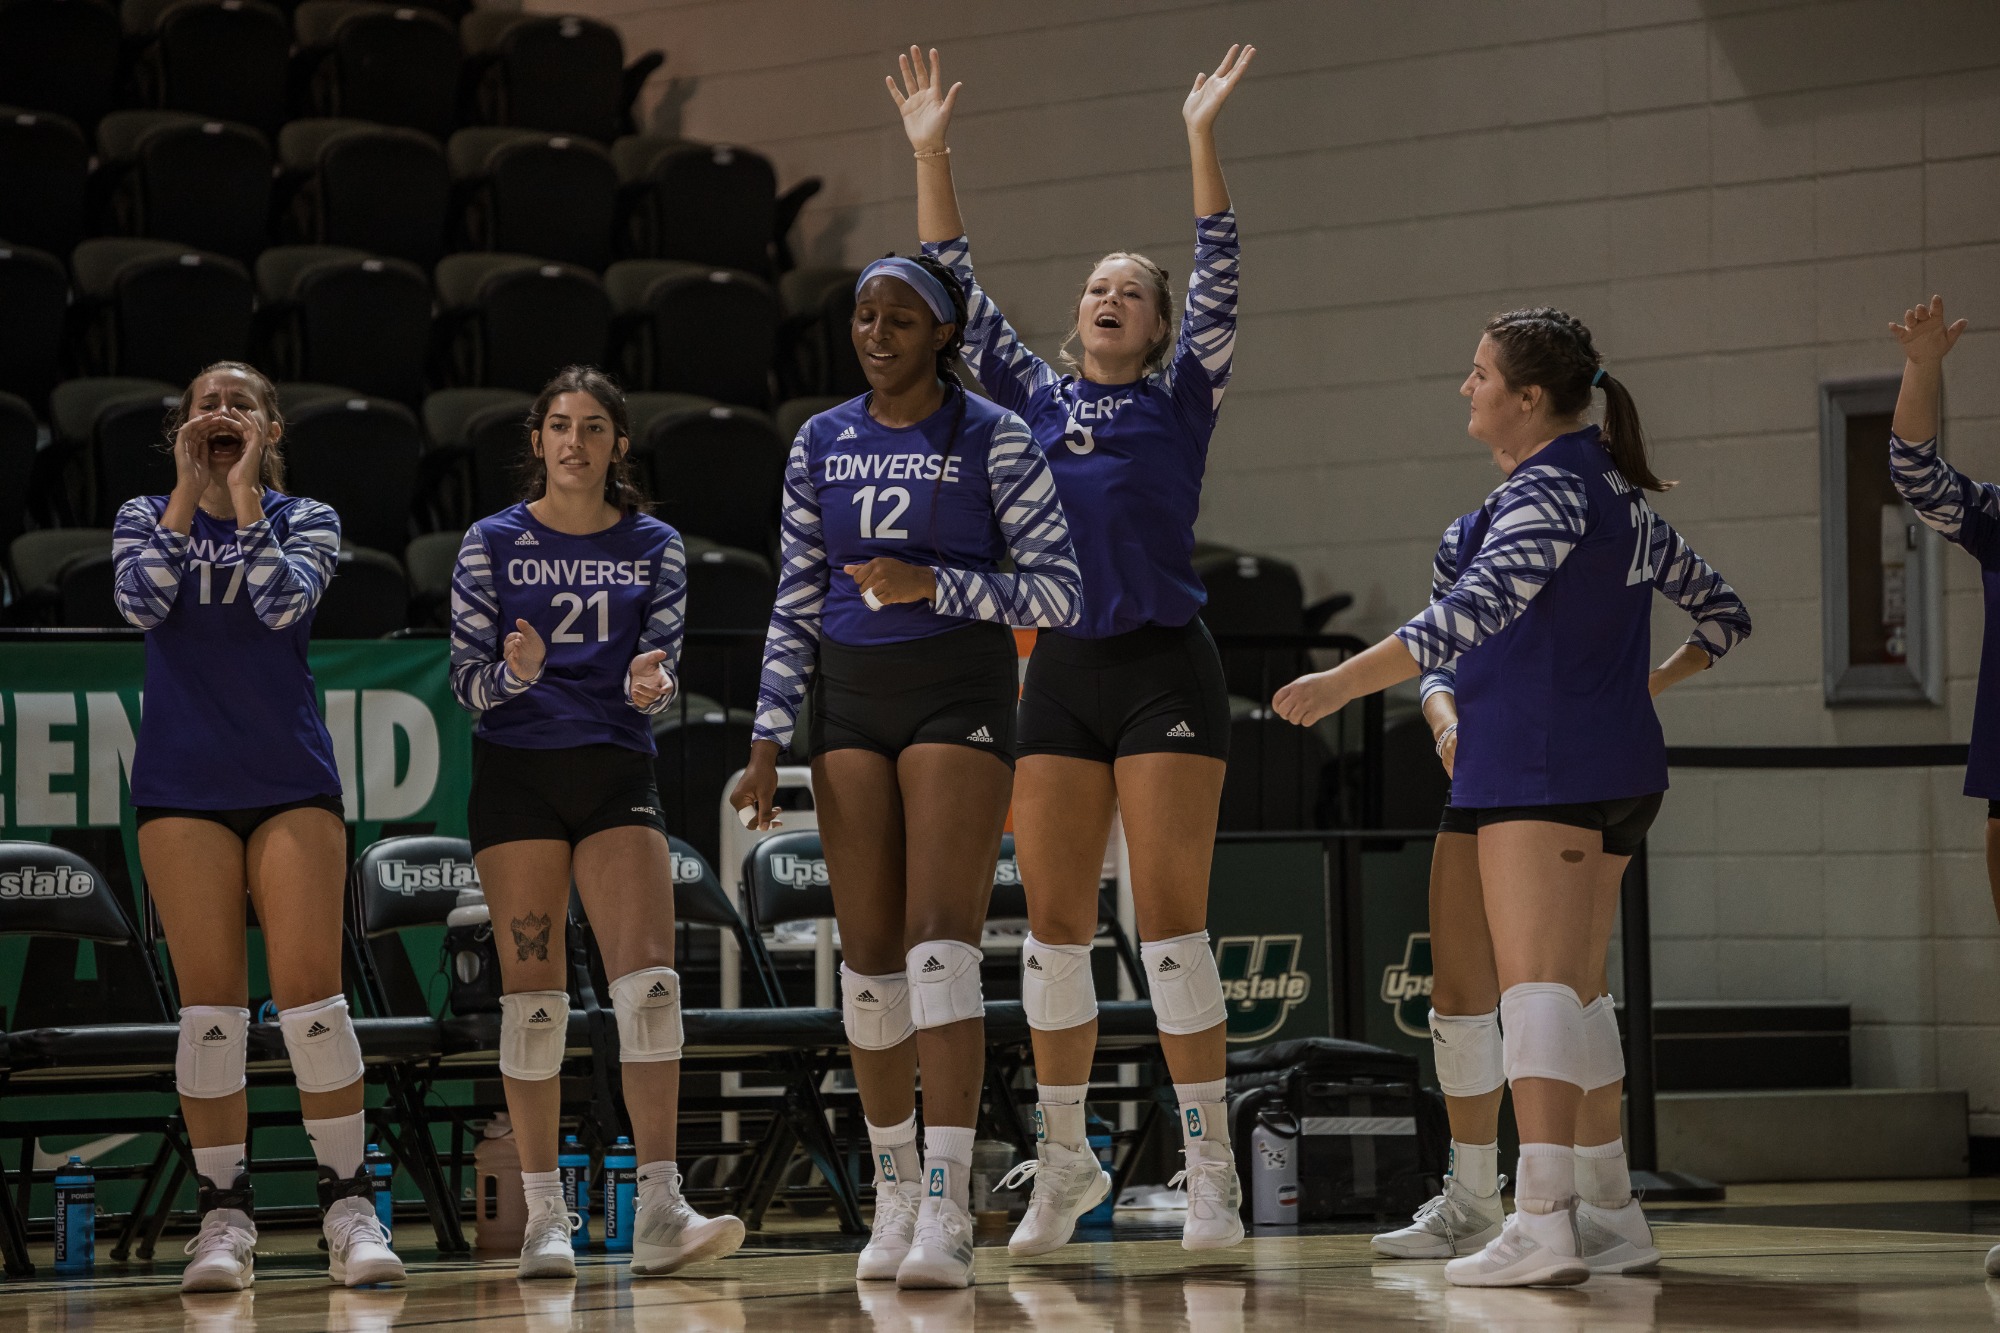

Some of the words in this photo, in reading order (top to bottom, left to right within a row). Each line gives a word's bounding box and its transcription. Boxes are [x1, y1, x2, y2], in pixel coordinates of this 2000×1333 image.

[1065, 416, 1095, 455] 5
[824, 454, 962, 483] CONVERSE
[851, 485, 911, 540] 12
[1625, 497, 1654, 587] 22
[189, 559, 245, 605] 17
[508, 559, 651, 586] CONVERSE
[551, 591, 609, 643] 21
[631, 806, 656, 816] adidas
[56, 1191, 65, 1260] POWERADE
[606, 1170, 615, 1238] POWERADE
